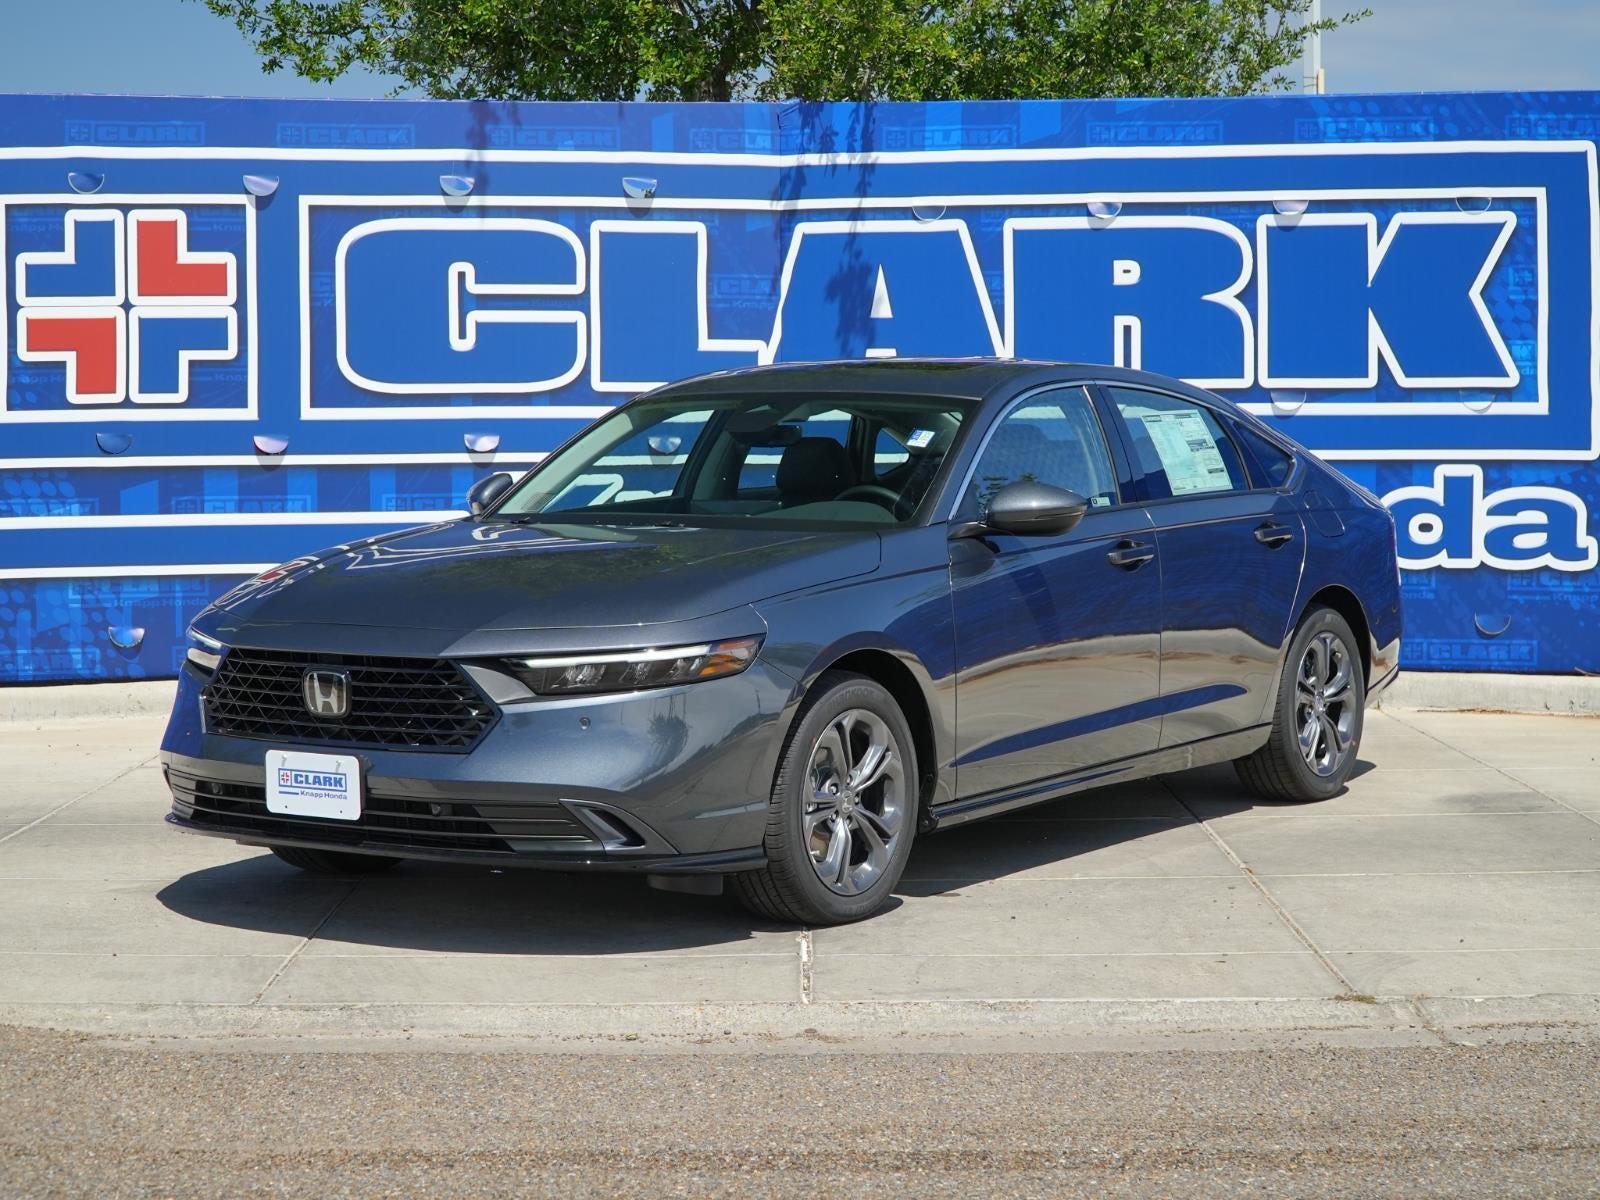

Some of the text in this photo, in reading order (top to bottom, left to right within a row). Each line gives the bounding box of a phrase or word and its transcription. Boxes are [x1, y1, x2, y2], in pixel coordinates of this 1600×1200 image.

[97, 126, 199, 142] CLARK
[307, 128, 409, 145] CLARK
[516, 130, 614, 147] CLARK
[912, 129, 1010, 146] CLARK
[1117, 126, 1217, 142] CLARK
[336, 211, 1520, 395] CLARK
[1429, 644, 1531, 660] CLARK
[293, 773, 344, 788] CLARK
[299, 790, 348, 800] Knapp Honda
